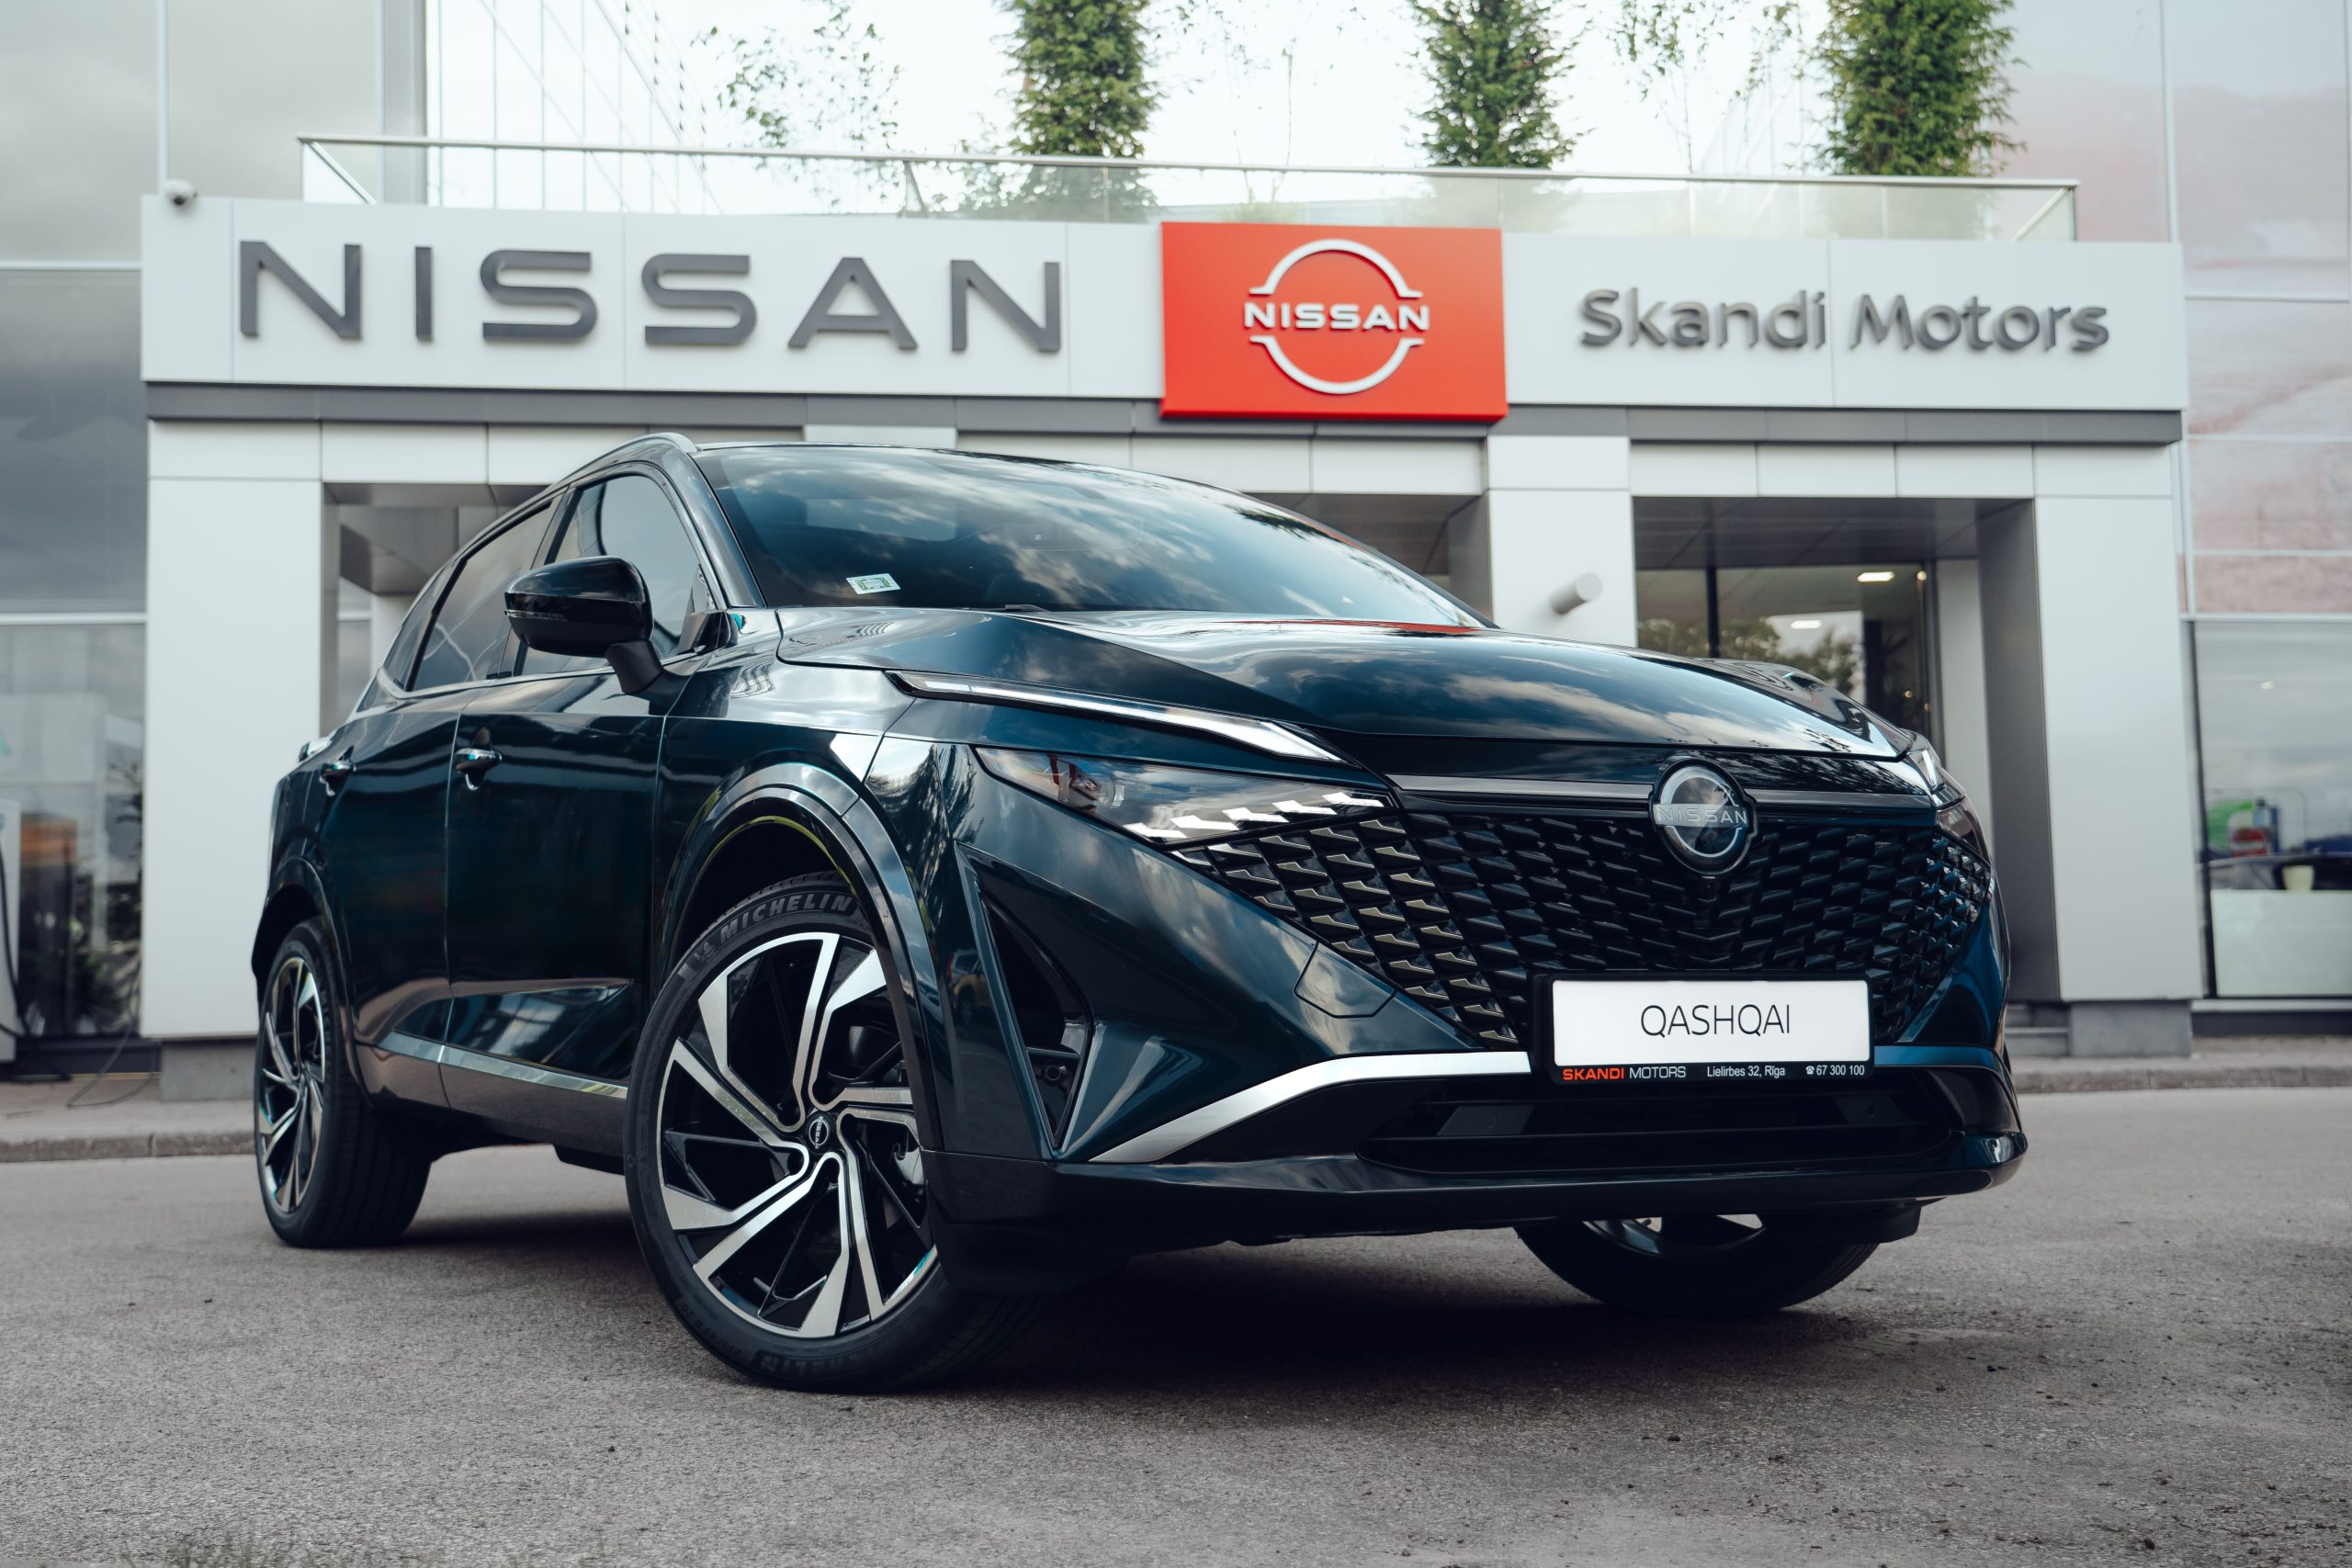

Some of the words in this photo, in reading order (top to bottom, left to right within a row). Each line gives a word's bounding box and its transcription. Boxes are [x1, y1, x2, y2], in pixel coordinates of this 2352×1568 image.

[240, 241, 1062, 353] NISSAN
[1243, 300, 1430, 331] NISSAN
[1579, 287, 1826, 348] Skandi
[1848, 293, 2110, 352] Motors
[1656, 807, 1748, 825] NISSAN
[720, 894, 853, 943] MICHELIN
[1640, 1004, 1791, 1038] QASHQAI
[1563, 1066, 1624, 1081] SKANDI
[1629, 1066, 1687, 1079] MOTORS
[1706, 1066, 1746, 1077] Lielirbes
[1747, 1065, 1762, 1078] 32,
[1764, 1065, 1786, 1079] Rīga
[1815, 1064, 1827, 1076] 67
[1829, 1064, 1847, 1076] 300
[1849, 1064, 1865, 1076] 100
